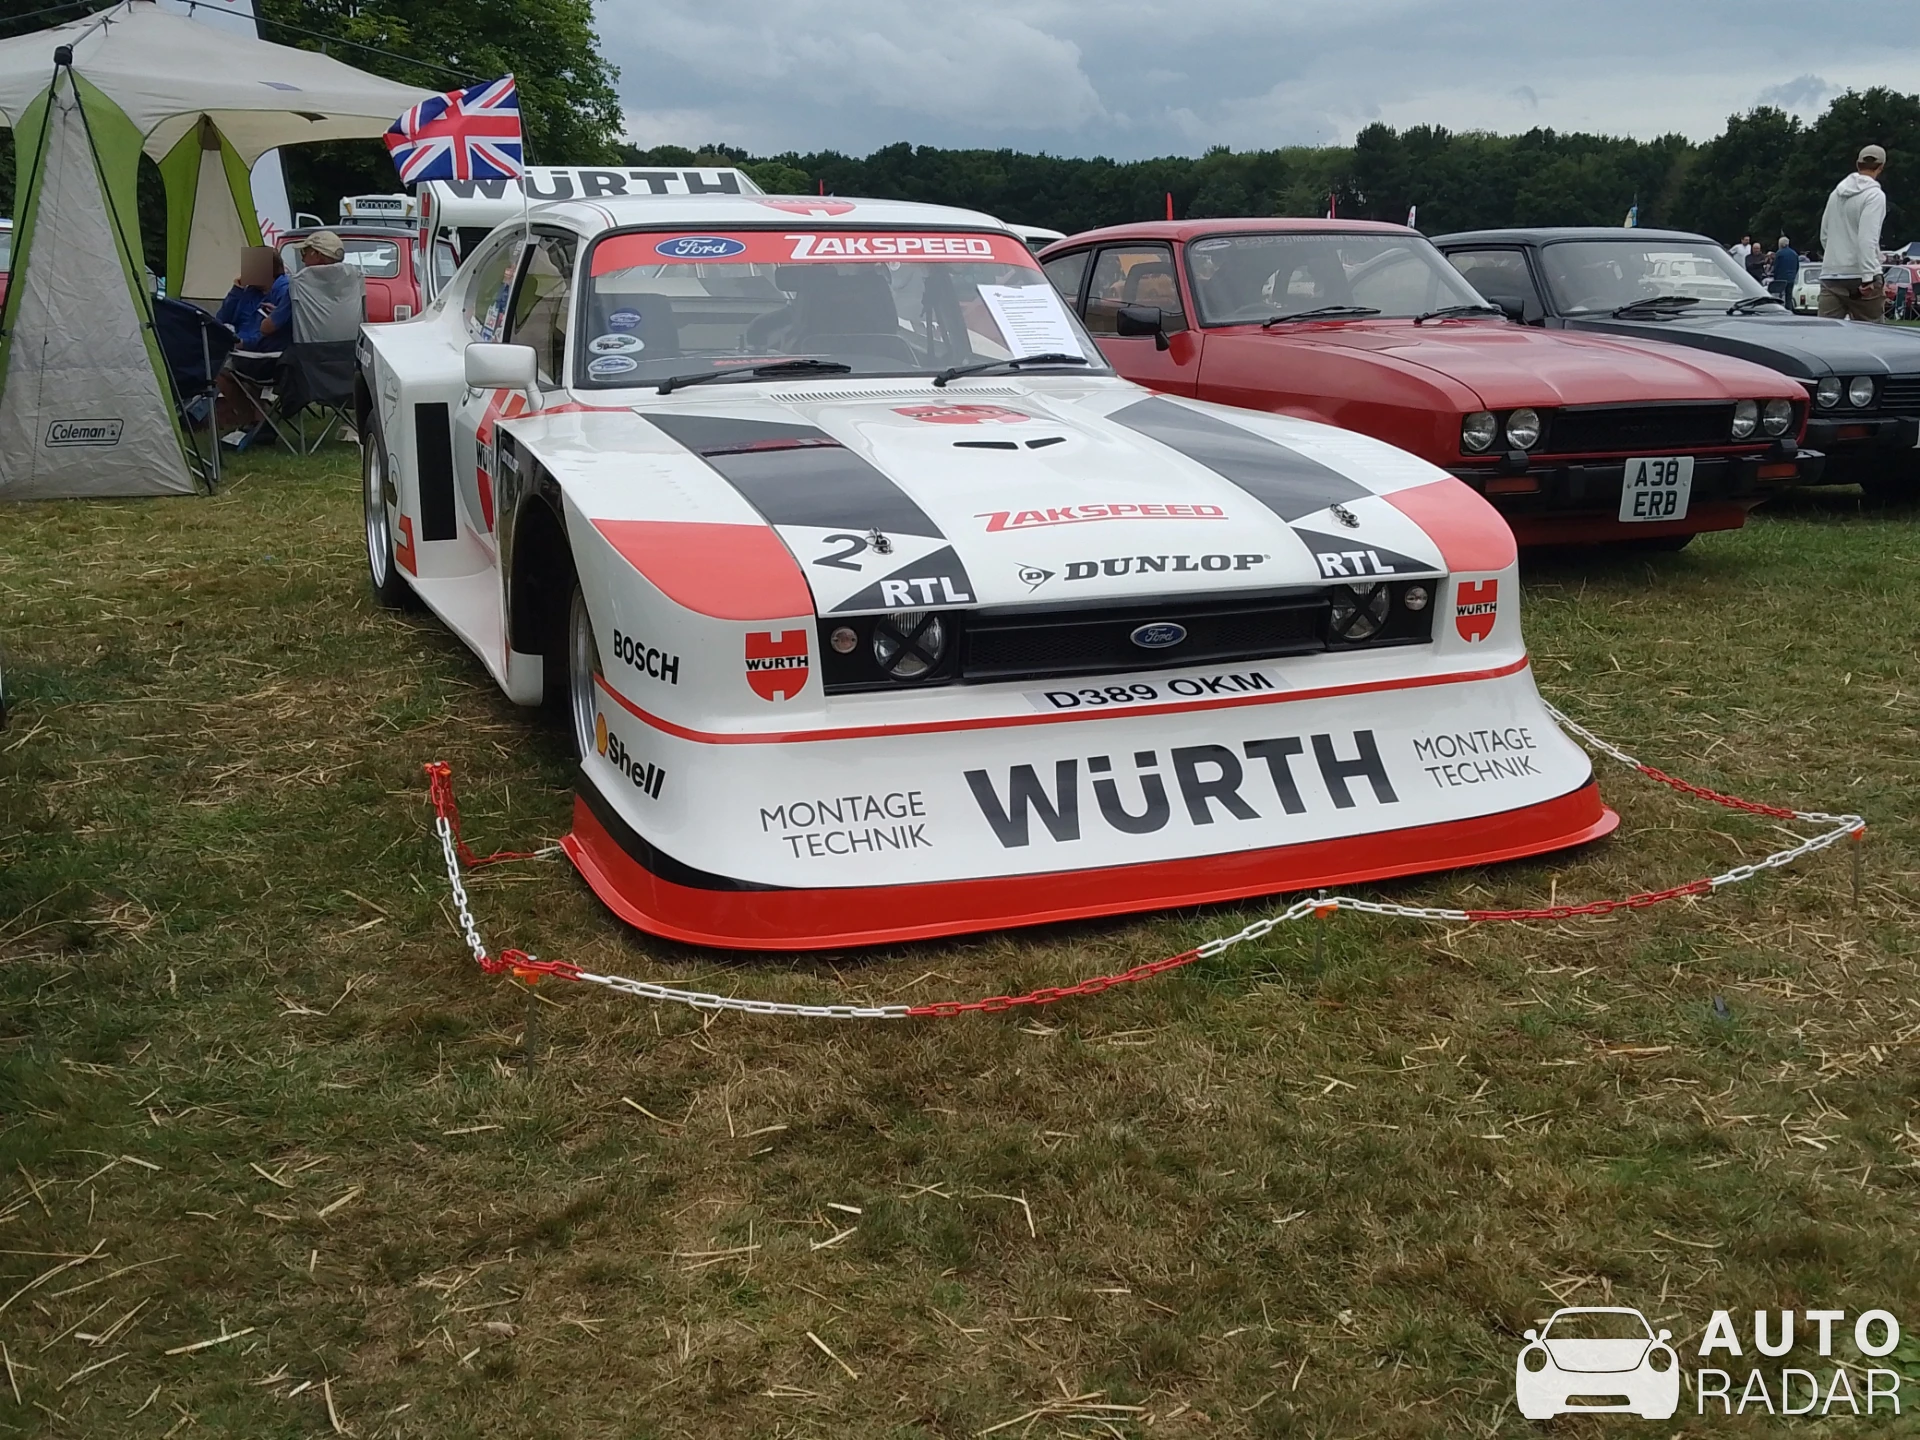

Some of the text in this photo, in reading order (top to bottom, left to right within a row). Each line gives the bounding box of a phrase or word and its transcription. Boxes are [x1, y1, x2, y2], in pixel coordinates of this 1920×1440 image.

[675, 239, 728, 254] Ford
[784, 235, 995, 259] ZAKSPEED
[52, 423, 106, 439] Coleman
[1634, 460, 1679, 487] A38
[973, 503, 1229, 532] ZAKSPEED
[1633, 491, 1677, 516] ERB
[812, 534, 868, 572] 2
[1316, 550, 1395, 577] RTL
[880, 577, 969, 607] RTL
[1145, 628, 1174, 643] Ford
[614, 628, 680, 685] BOSCH
[746, 656, 809, 671] WÜRTH
[1045, 672, 1275, 709] D389 OKM
[1412, 726, 1536, 761] MONTAGE
[608, 732, 666, 801] Shell
[1424, 754, 1542, 789] TECHNIK
[964, 730, 1400, 848] WÜRTH
[760, 792, 926, 832] MONTAGE
[782, 824, 933, 858] TECHNIK
